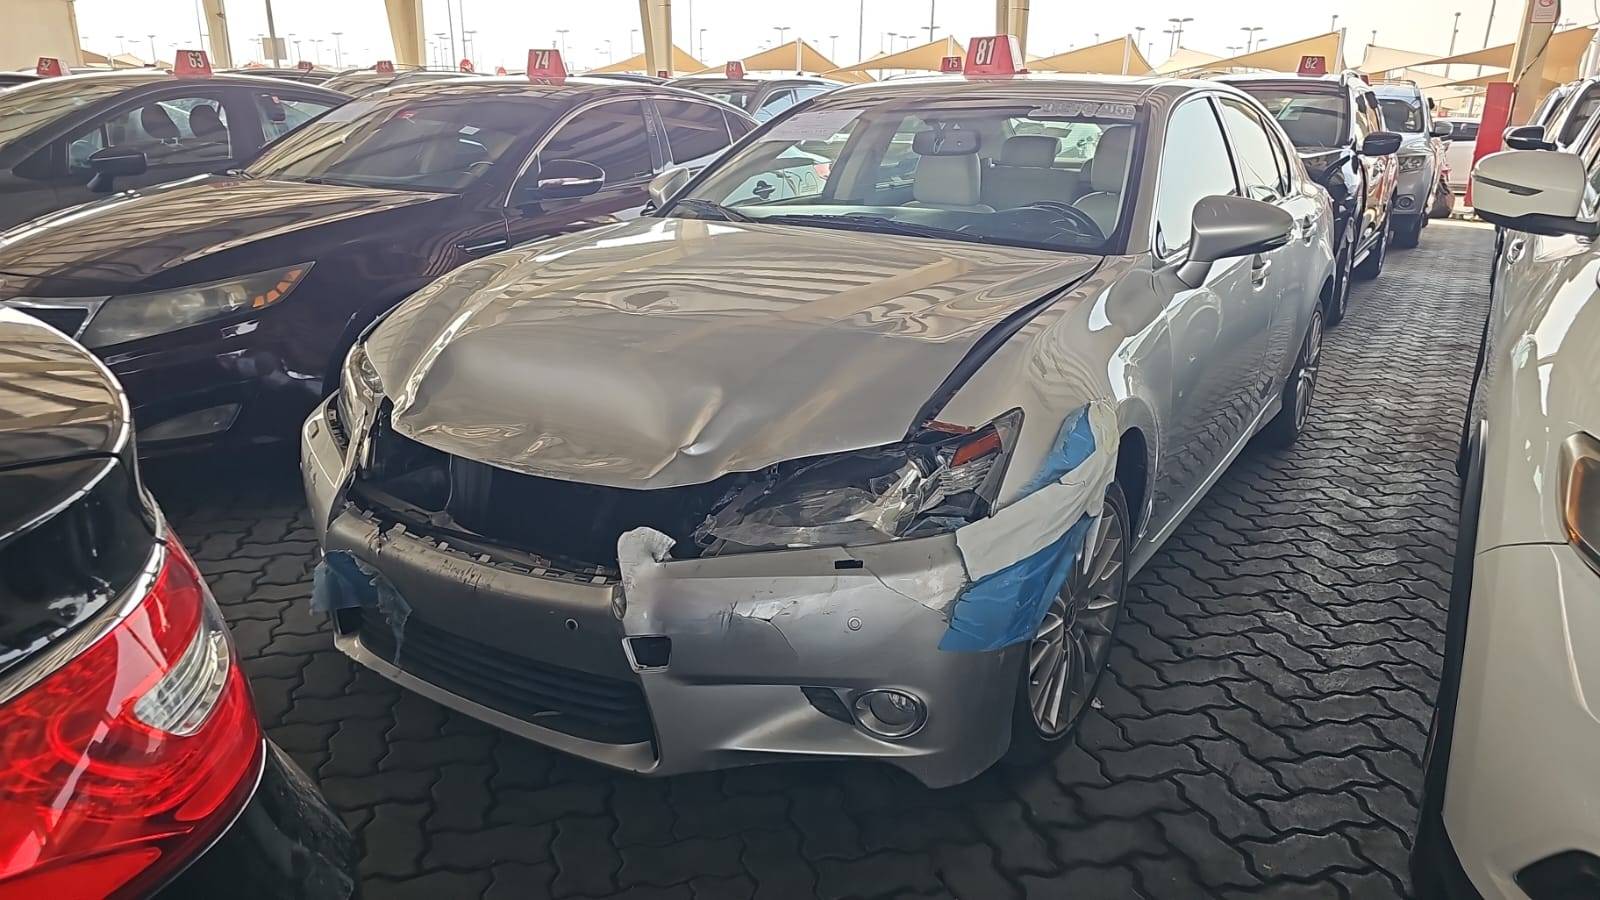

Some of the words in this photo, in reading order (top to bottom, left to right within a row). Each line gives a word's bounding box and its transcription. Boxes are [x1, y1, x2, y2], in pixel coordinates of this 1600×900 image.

[188, 51, 205, 68] 63
[535, 50, 549, 69] 74
[975, 38, 996, 65] 81
[948, 57, 958, 68] 75
[1305, 56, 1317, 69] 82
